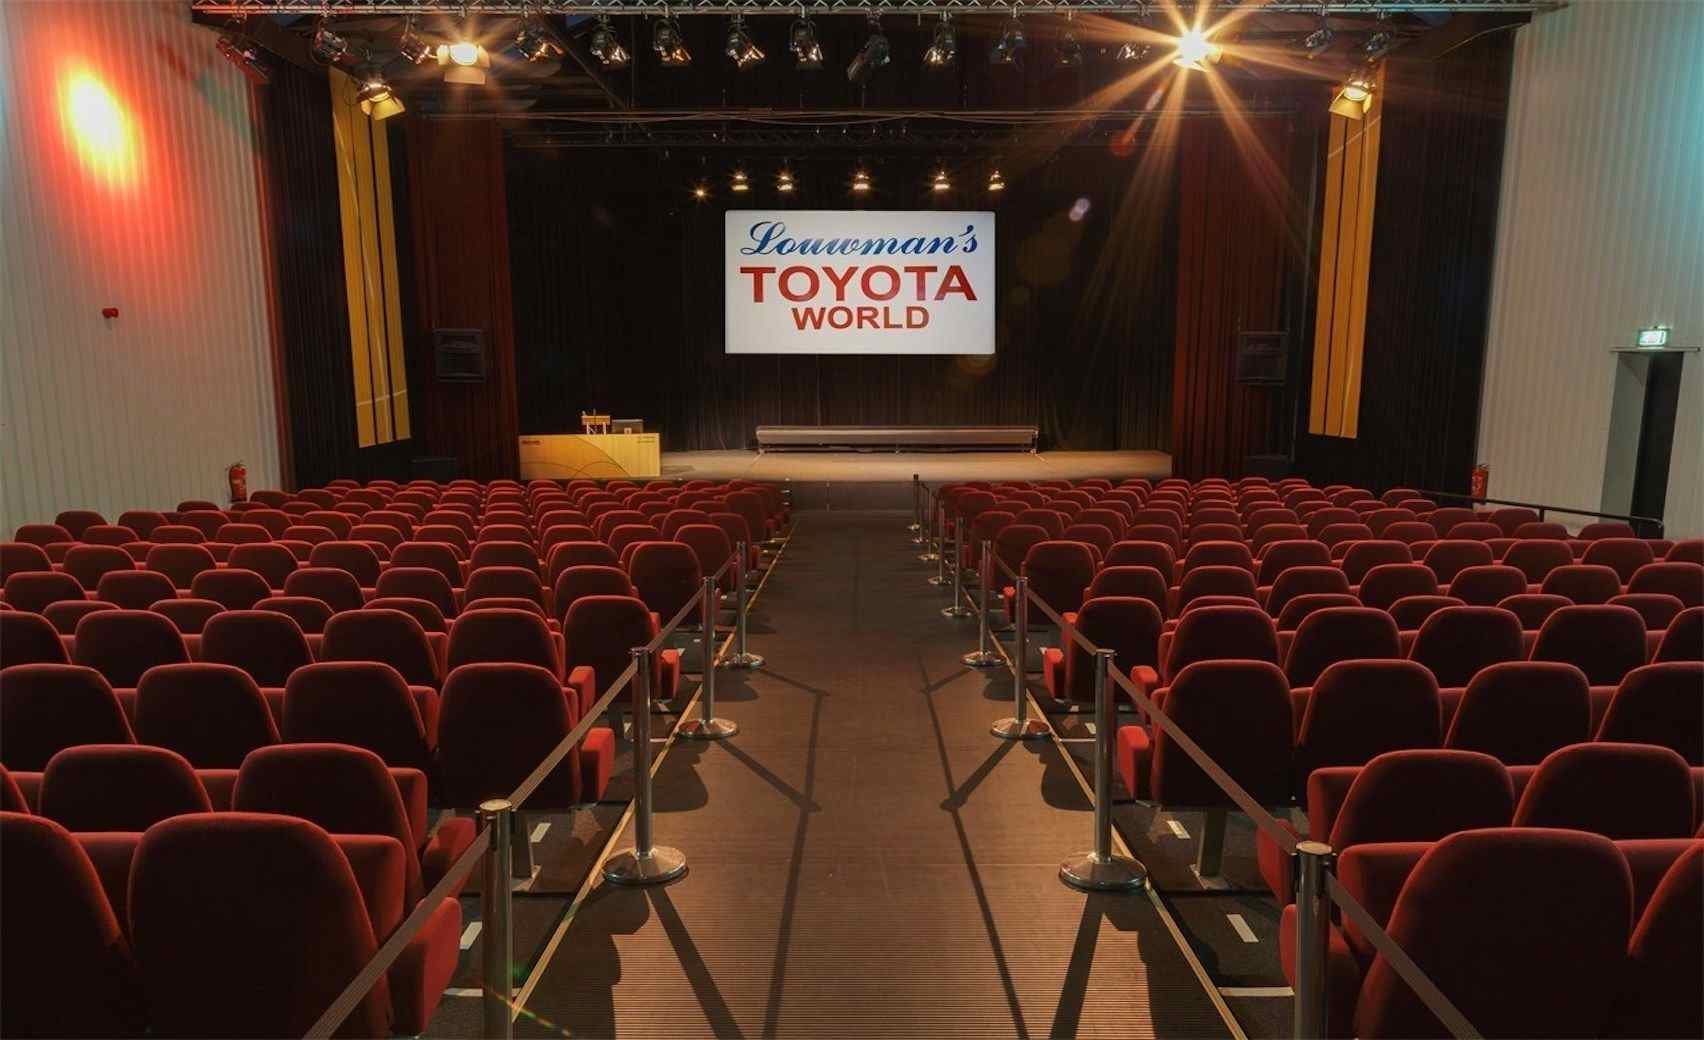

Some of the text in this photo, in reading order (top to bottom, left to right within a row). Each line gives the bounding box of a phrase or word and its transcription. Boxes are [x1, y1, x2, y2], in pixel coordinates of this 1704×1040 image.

[740, 221, 978, 256] Louwman's
[740, 265, 978, 303] TOYOTA
[791, 306, 930, 330] WORLD
